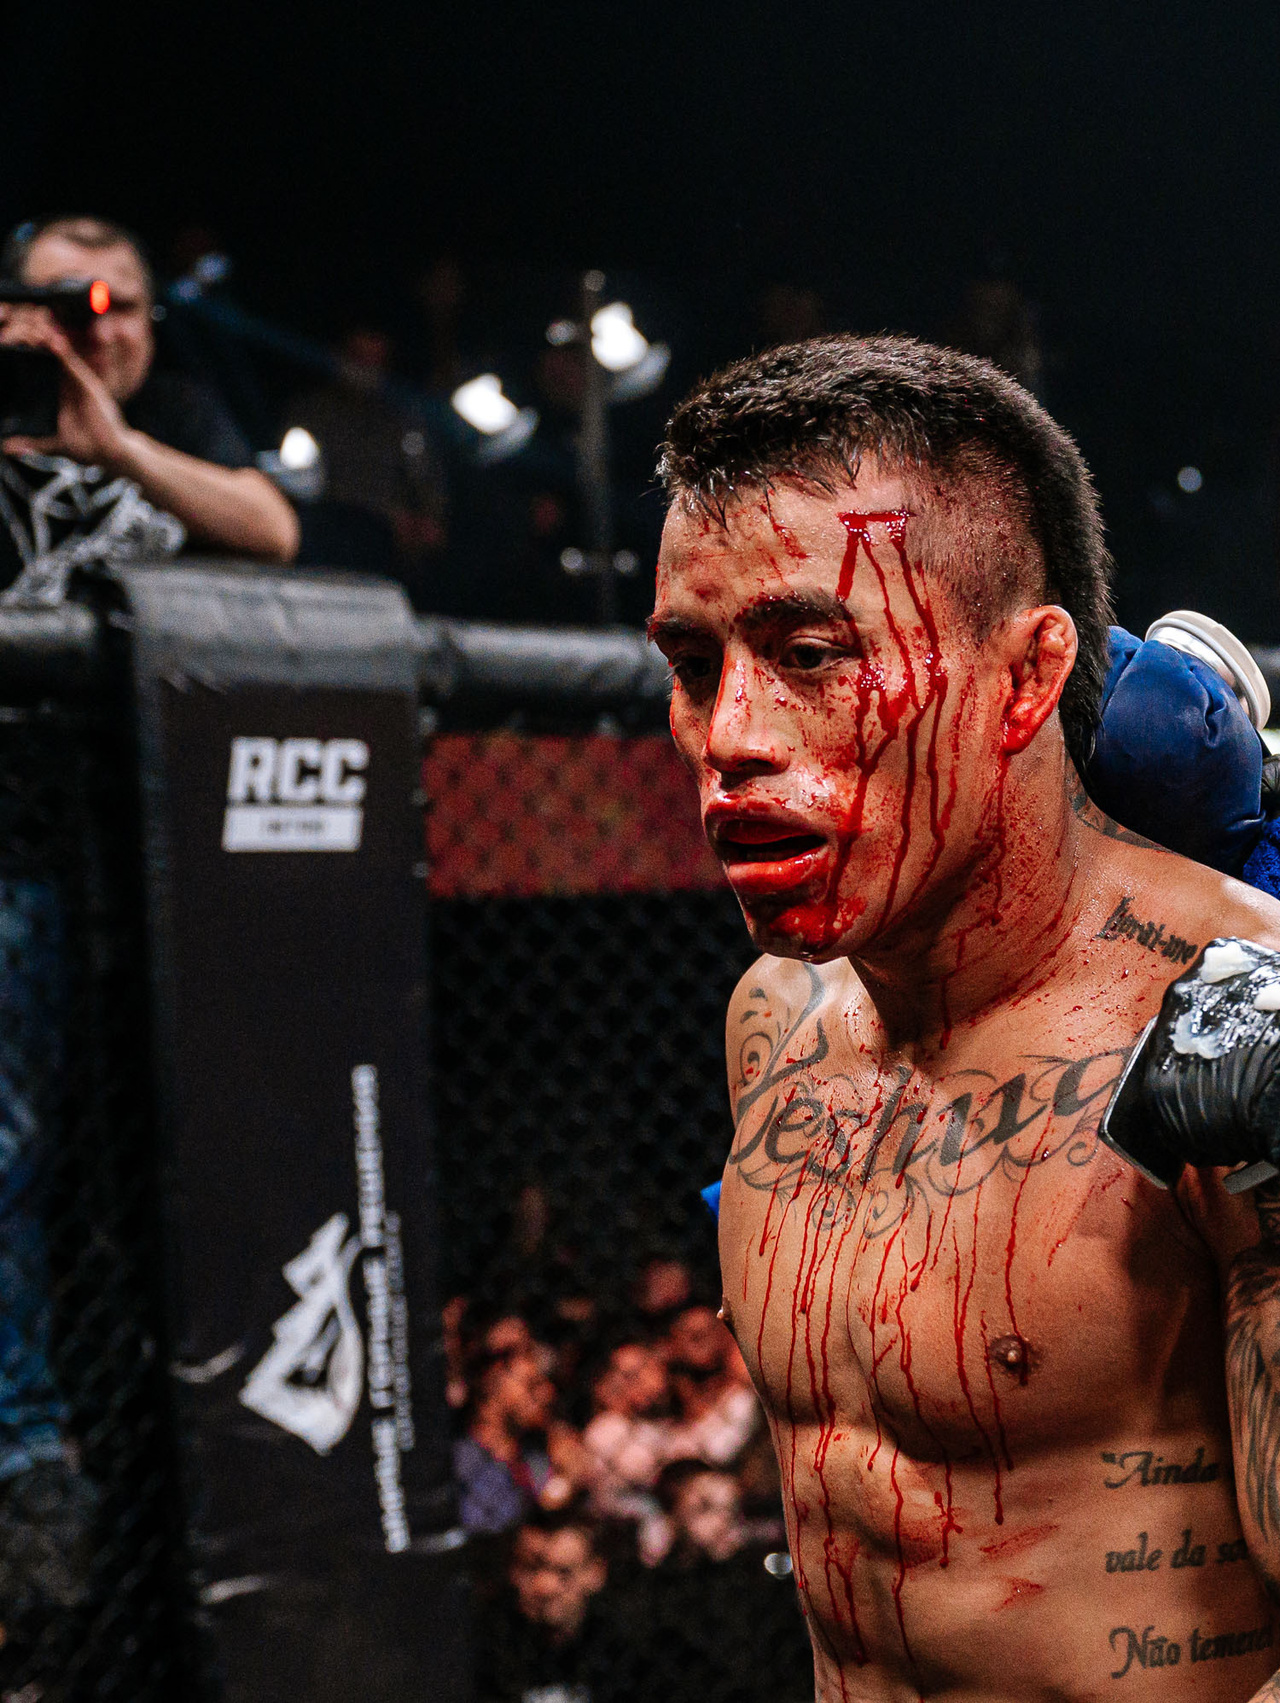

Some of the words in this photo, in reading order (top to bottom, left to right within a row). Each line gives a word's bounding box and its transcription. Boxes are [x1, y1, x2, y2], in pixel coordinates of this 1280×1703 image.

[228, 736, 370, 802] RCC
[1171, 1528, 1206, 1569] da
[1108, 1625, 1181, 1680] Não
